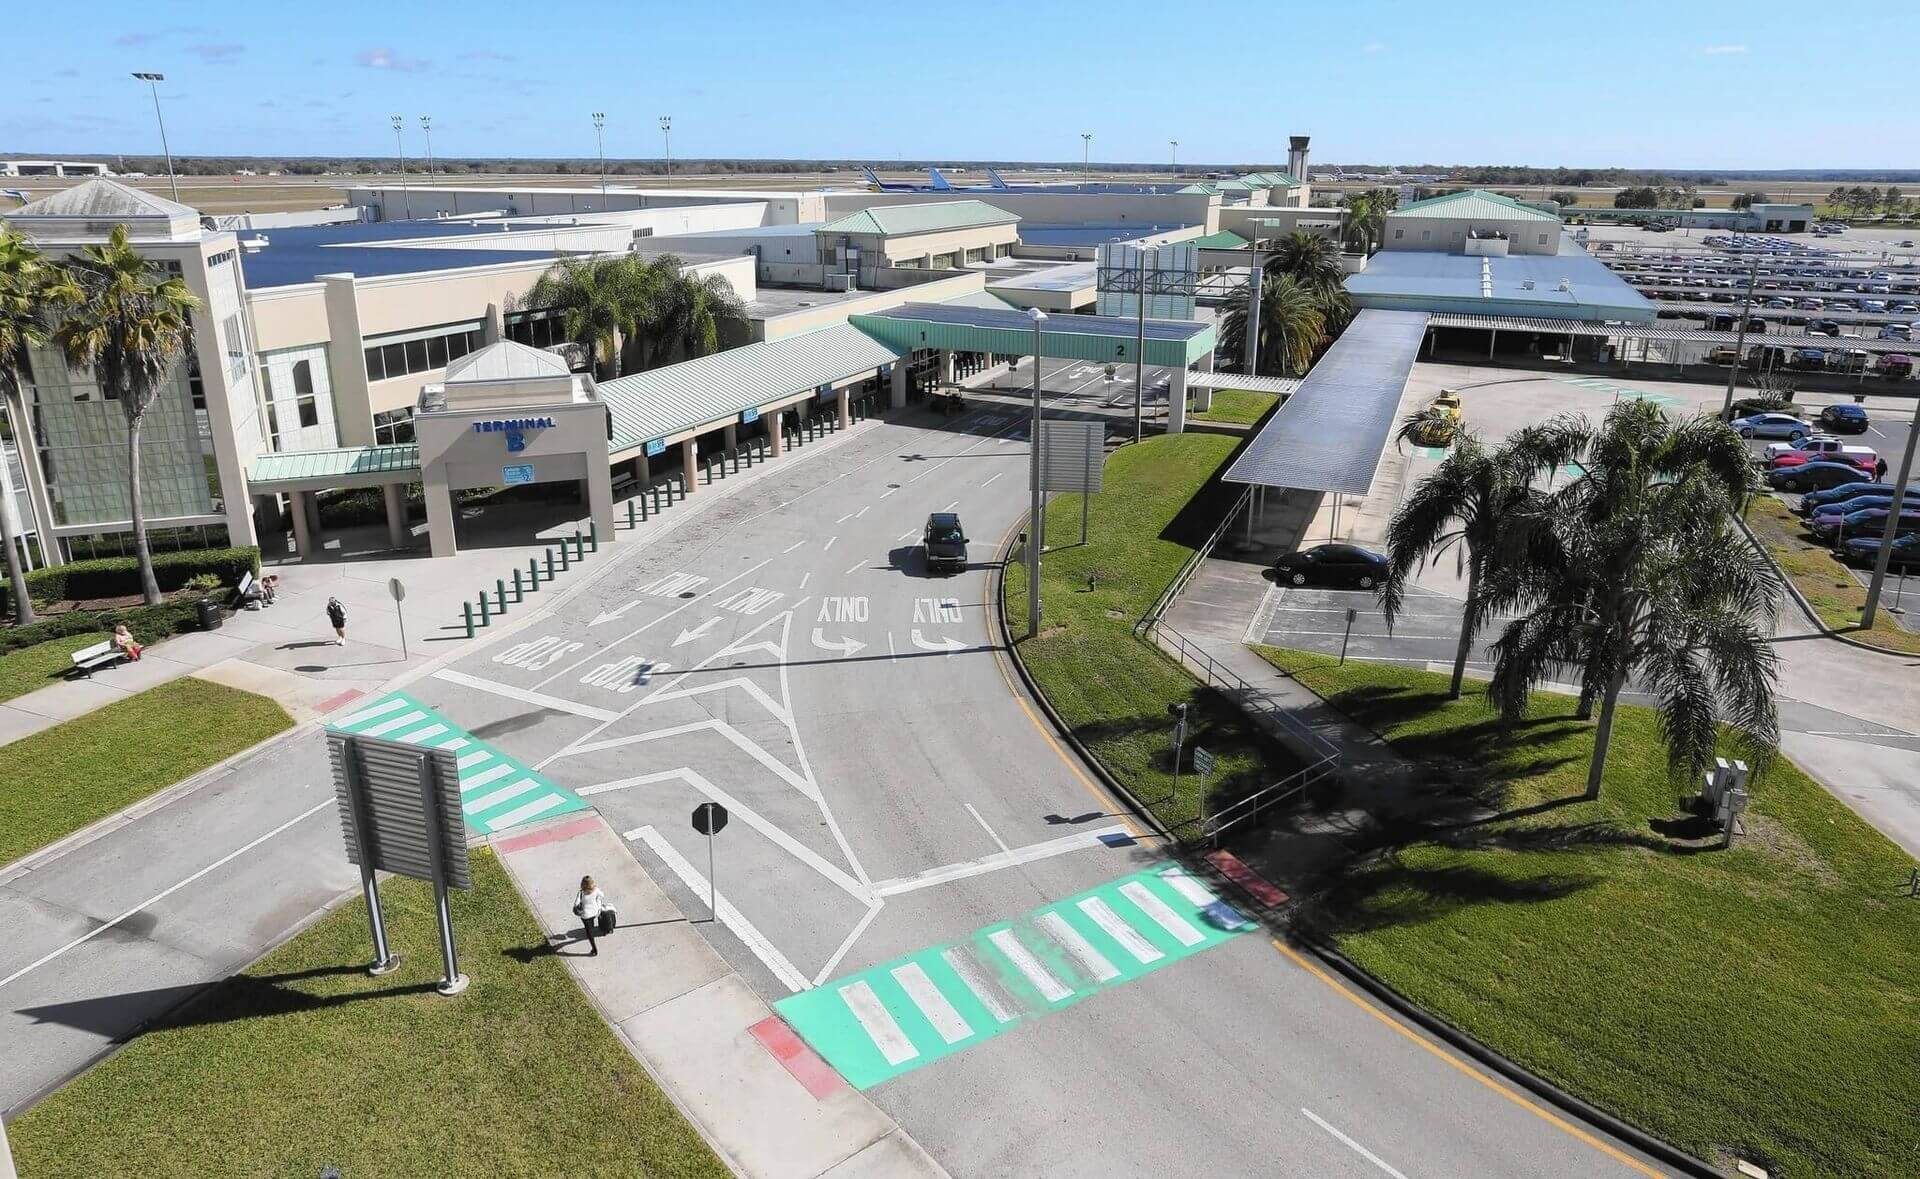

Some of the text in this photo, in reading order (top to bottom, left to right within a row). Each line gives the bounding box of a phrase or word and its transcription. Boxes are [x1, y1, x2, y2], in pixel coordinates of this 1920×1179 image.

[1116, 345, 1124, 357] 2
[472, 417, 556, 434] TERMINAL
[506, 432, 526, 453] B
[816, 596, 870, 623] ONLY
[912, 598, 964, 624] ONLY
[491, 635, 585, 671] STOP
